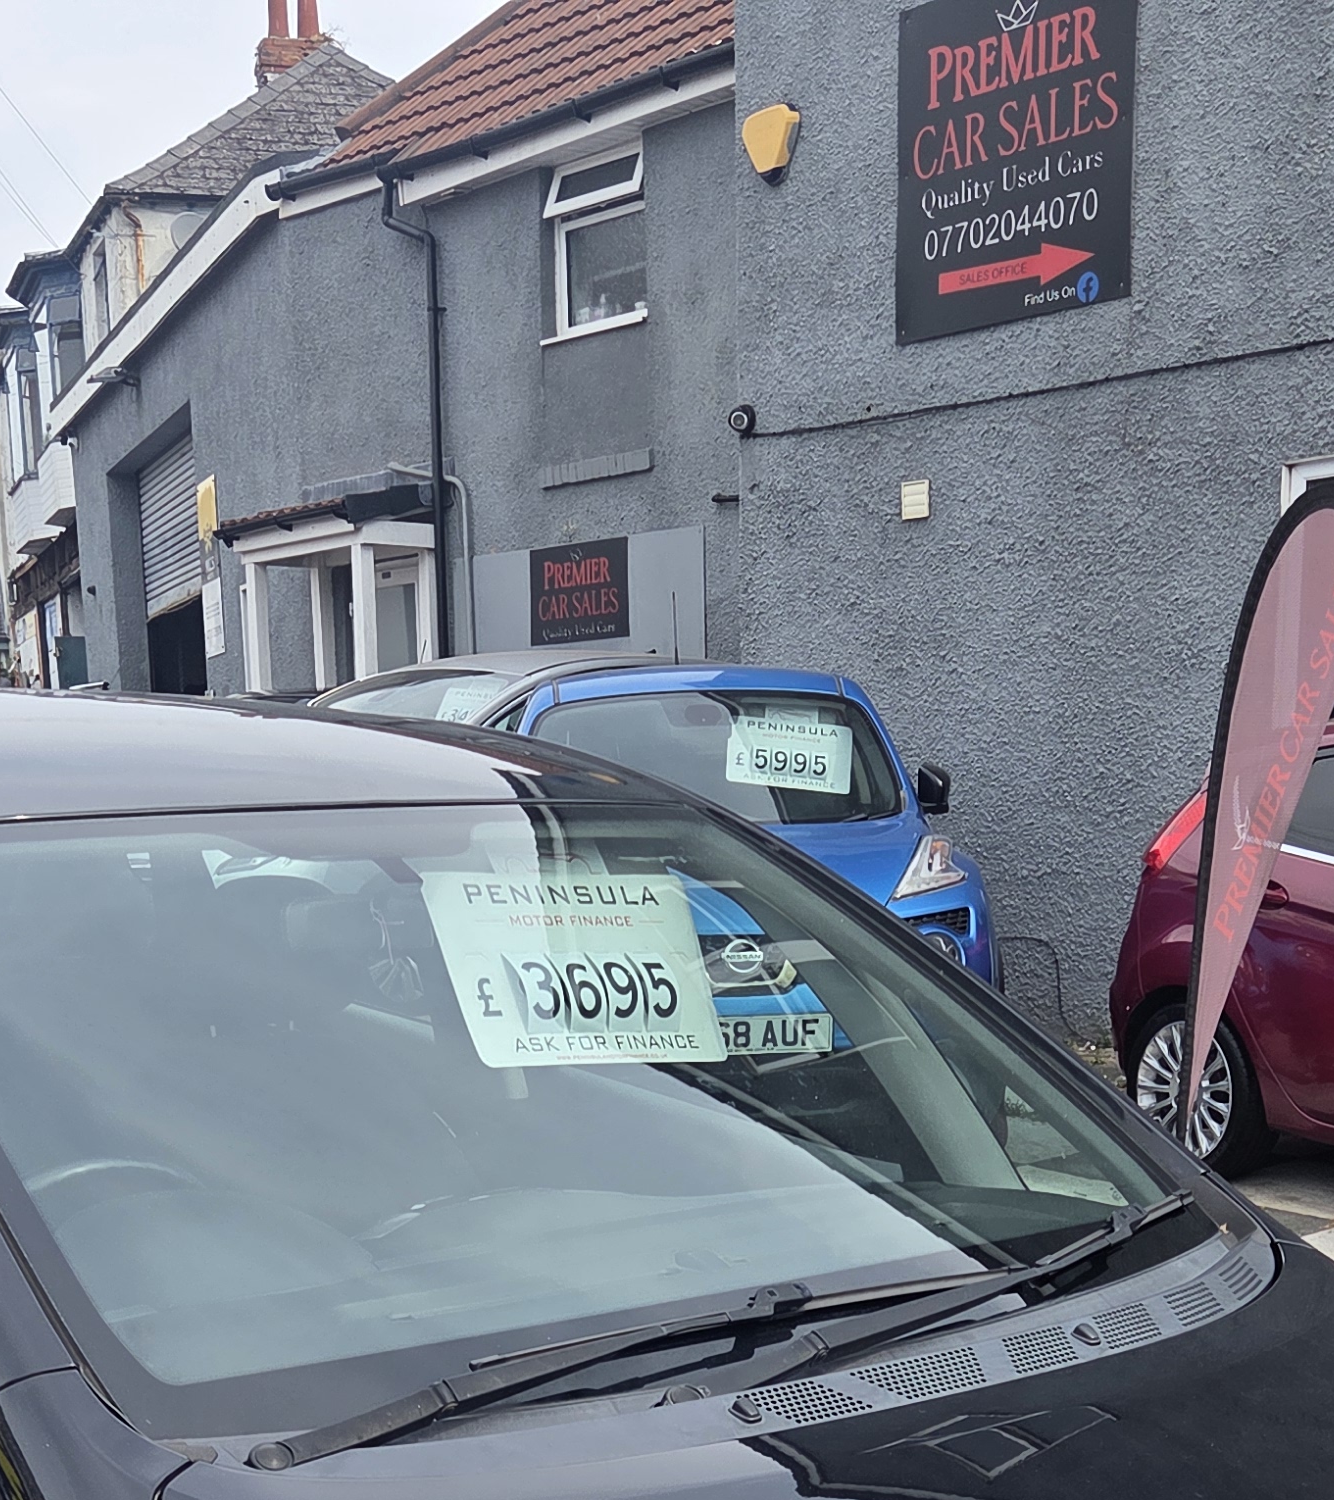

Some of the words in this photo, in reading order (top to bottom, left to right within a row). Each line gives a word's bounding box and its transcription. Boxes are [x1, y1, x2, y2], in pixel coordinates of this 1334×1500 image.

[927, 6, 1100, 110] PREMIER
[913, 112, 988, 180] CAR
[998, 71, 1118, 157] SALES
[921, 179, 995, 218] Quality
[1002, 156, 1050, 192] Used
[1057, 150, 1103, 177] Cars
[924, 187, 1098, 260] 07702044070
[958, 268, 990, 286] SALES
[991, 261, 1027, 280] OFFICE
[1024, 292, 1045, 306] Find
[1046, 289, 1060, 302] Us
[1061, 286, 1076, 299] On
[543, 556, 611, 590] PREMIER
[538, 594, 570, 621] CAR
[572, 588, 619, 618] SALES
[747, 720, 838, 737] PENINSULA
[792, 778, 836, 789] FINANCE
[1214, 762, 1291, 943] PREMIER
[1280, 681, 1320, 756] CAR
[464, 884, 660, 906] PENINSULA
[509, 915, 565, 928] MOTOR
[569, 915, 634, 928] FINANCE
[726, 951, 763, 962] NISSAN
[515, 1035, 557, 1054] ASK
[566, 1035, 610, 1052] FOR
[615, 1033, 701, 1052] FINANCE
[761, 1017, 820, 1049] AUF
